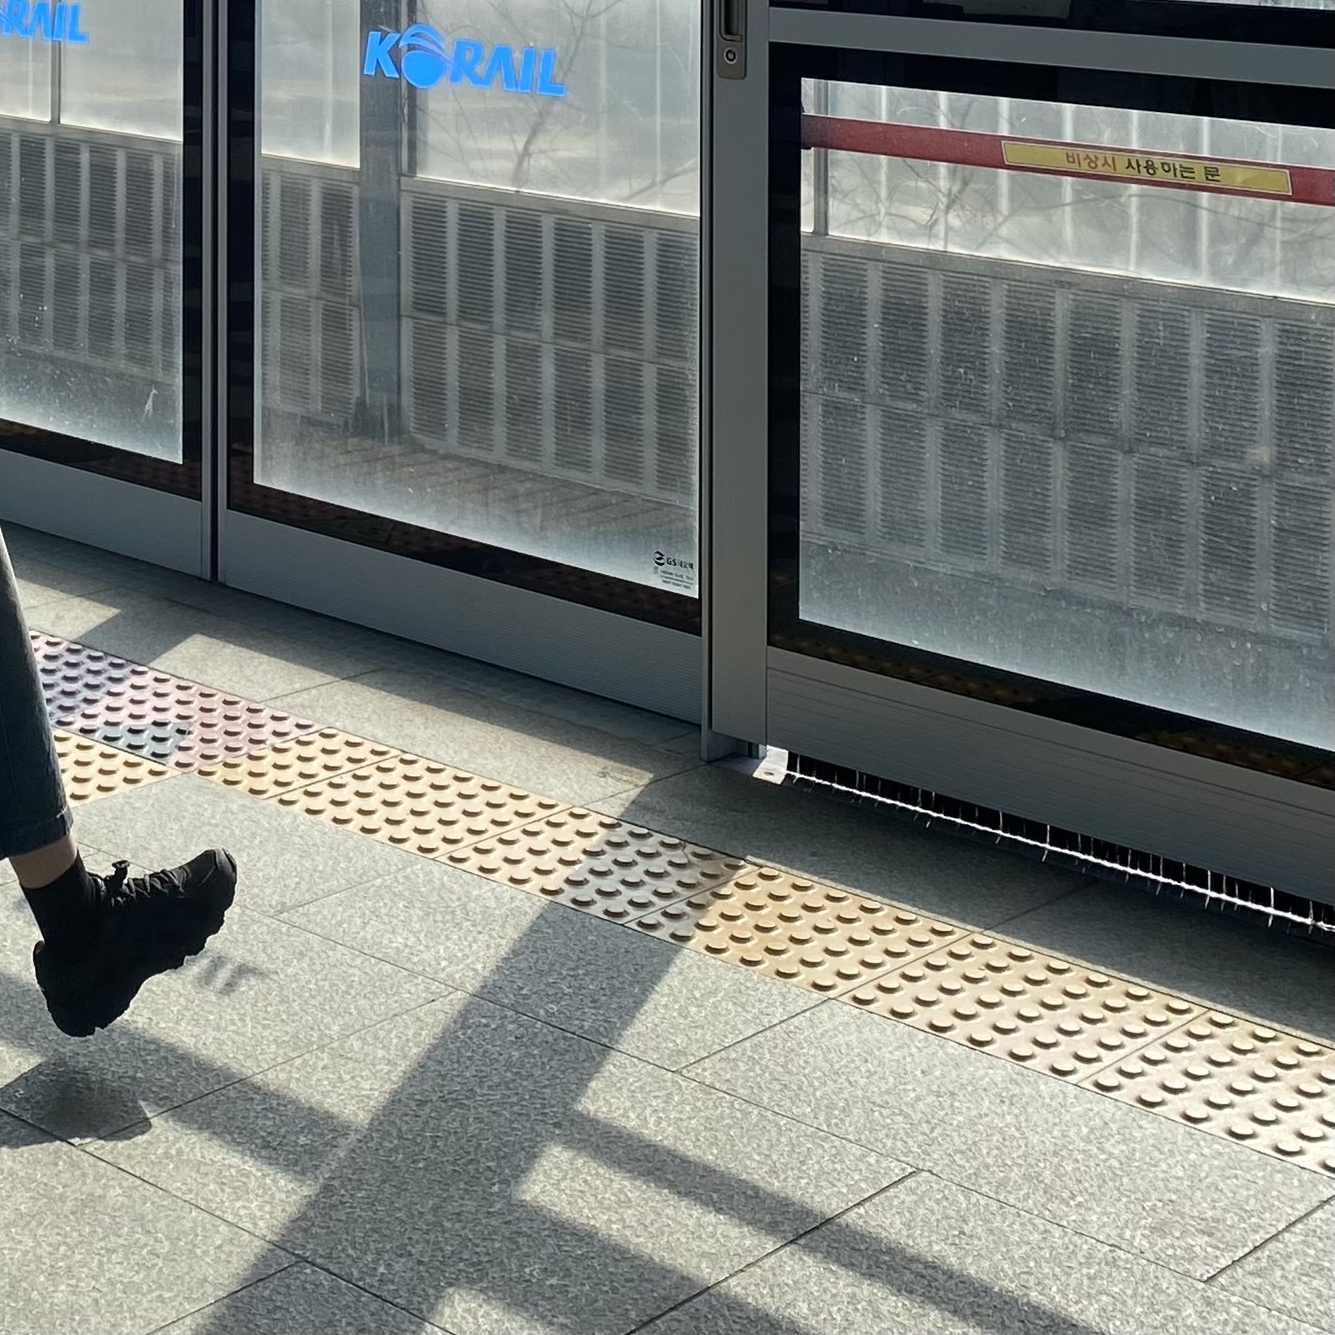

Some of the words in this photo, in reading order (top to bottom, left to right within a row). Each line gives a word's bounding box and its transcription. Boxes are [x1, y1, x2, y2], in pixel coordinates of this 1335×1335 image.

[363, 23, 567, 97] KORAIL
[1065, 151, 1117, 173] 비상시
[1124, 156, 1196, 180] 사용하는
[1203, 165, 1222, 183] 문
